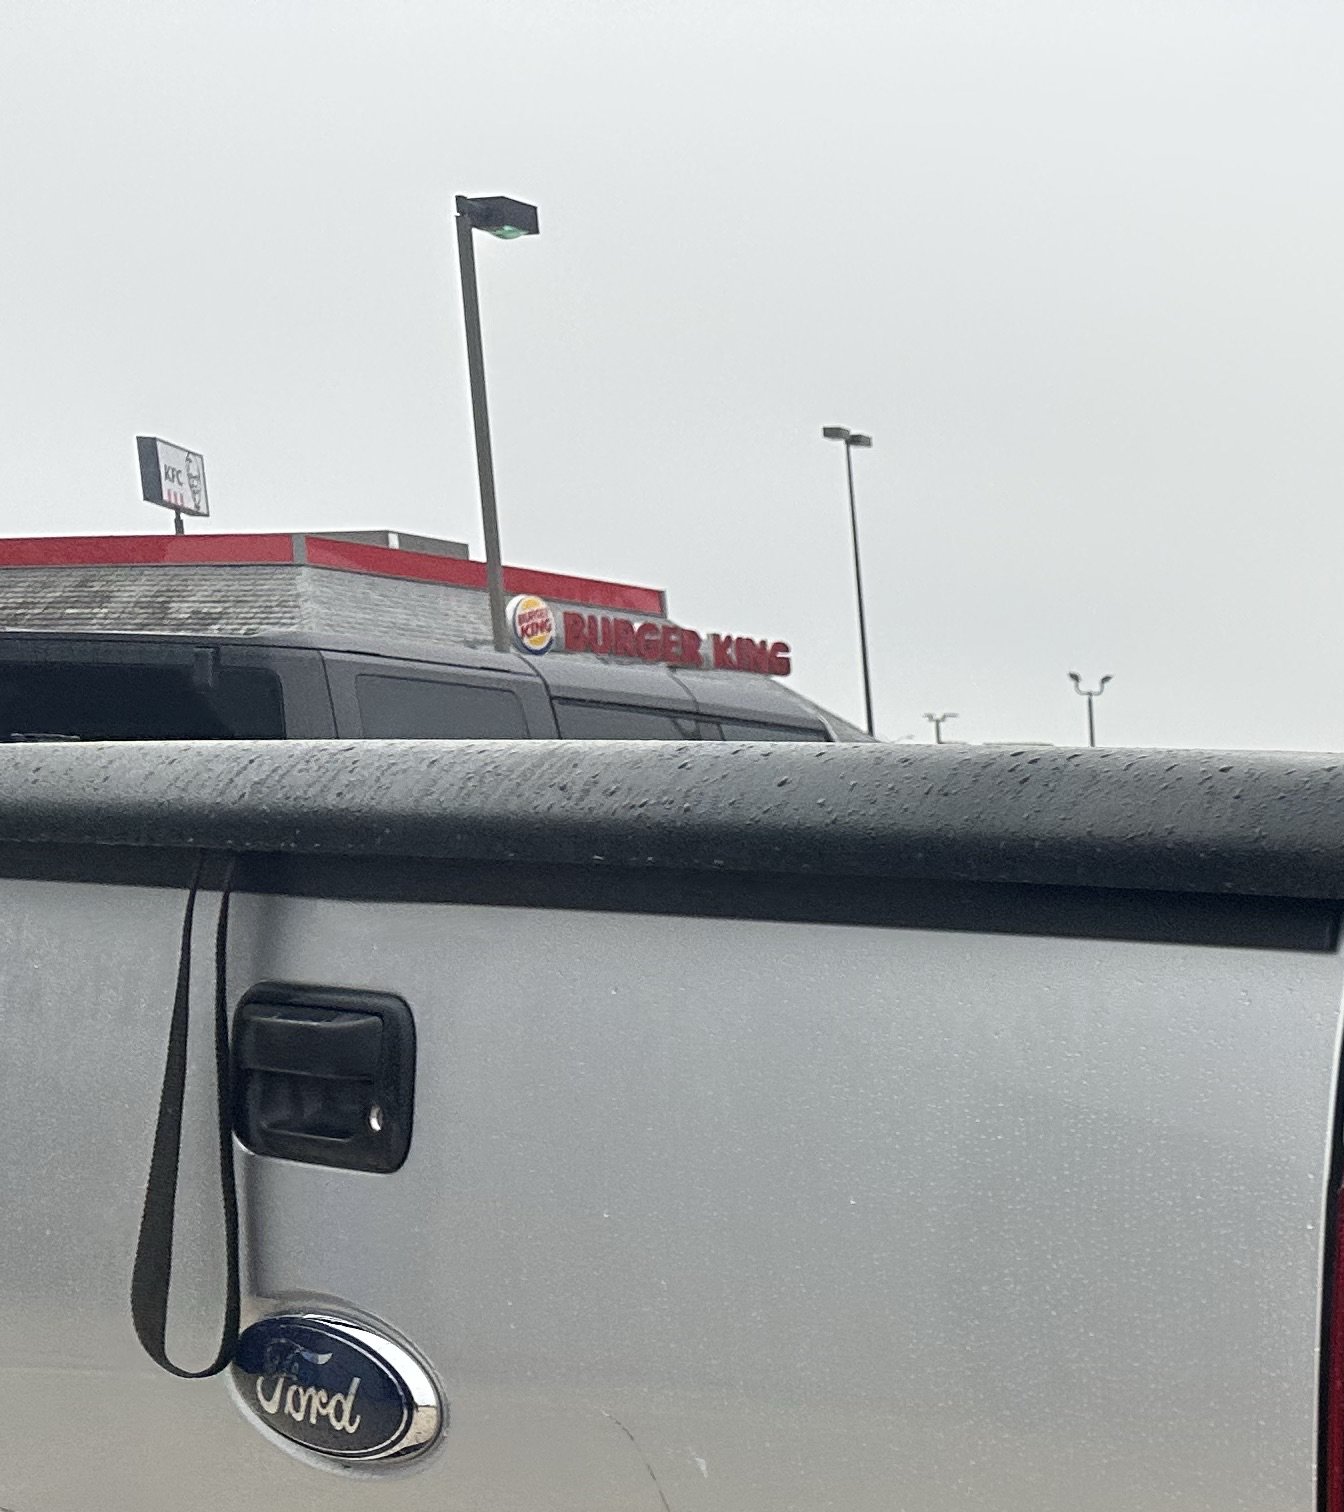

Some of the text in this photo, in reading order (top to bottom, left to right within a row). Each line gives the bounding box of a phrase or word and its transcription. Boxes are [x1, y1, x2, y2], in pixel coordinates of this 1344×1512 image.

[164, 463, 184, 487] KFC
[563, 610, 792, 676] BURGER KING
[254, 1345, 361, 1434] Ford
